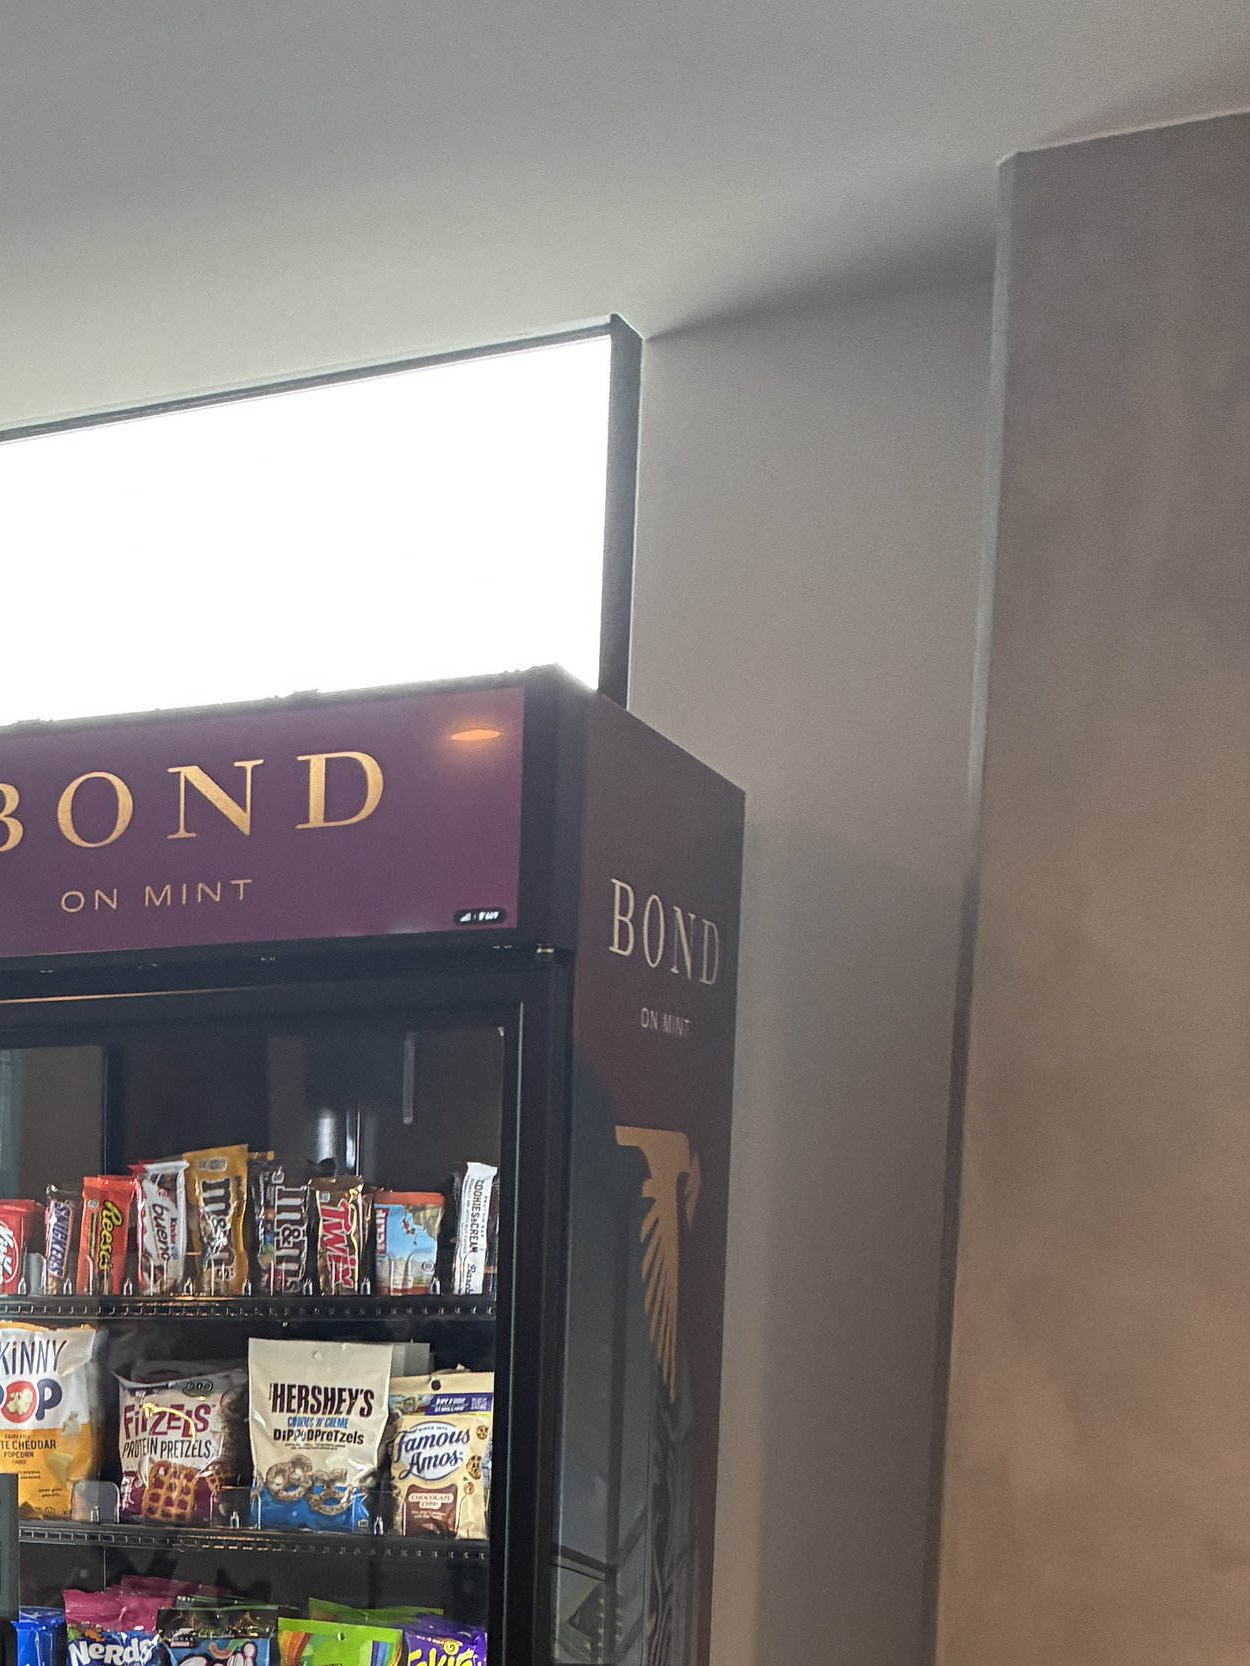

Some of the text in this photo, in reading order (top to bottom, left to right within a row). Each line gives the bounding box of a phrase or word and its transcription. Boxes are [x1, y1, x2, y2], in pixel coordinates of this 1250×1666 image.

[59, 879, 254, 913] ON MINT
[609, 878, 719, 985] BOND
[641, 1007, 691, 1036] ON MINT
[152, 1203, 170, 1261] bueno
[271, 1383, 375, 1418] HERSHEY'S
[4, 1451, 34, 1459] POPCORN
[12, 1440, 56, 1450] CHEDDAR
[123, 1437, 212, 1459] PROTEIN PRETZELS
[395, 1428, 470, 1463] Famous
[399, 1448, 458, 1480] Amos
[411, 1493, 452, 1501] CHOCOLATE
